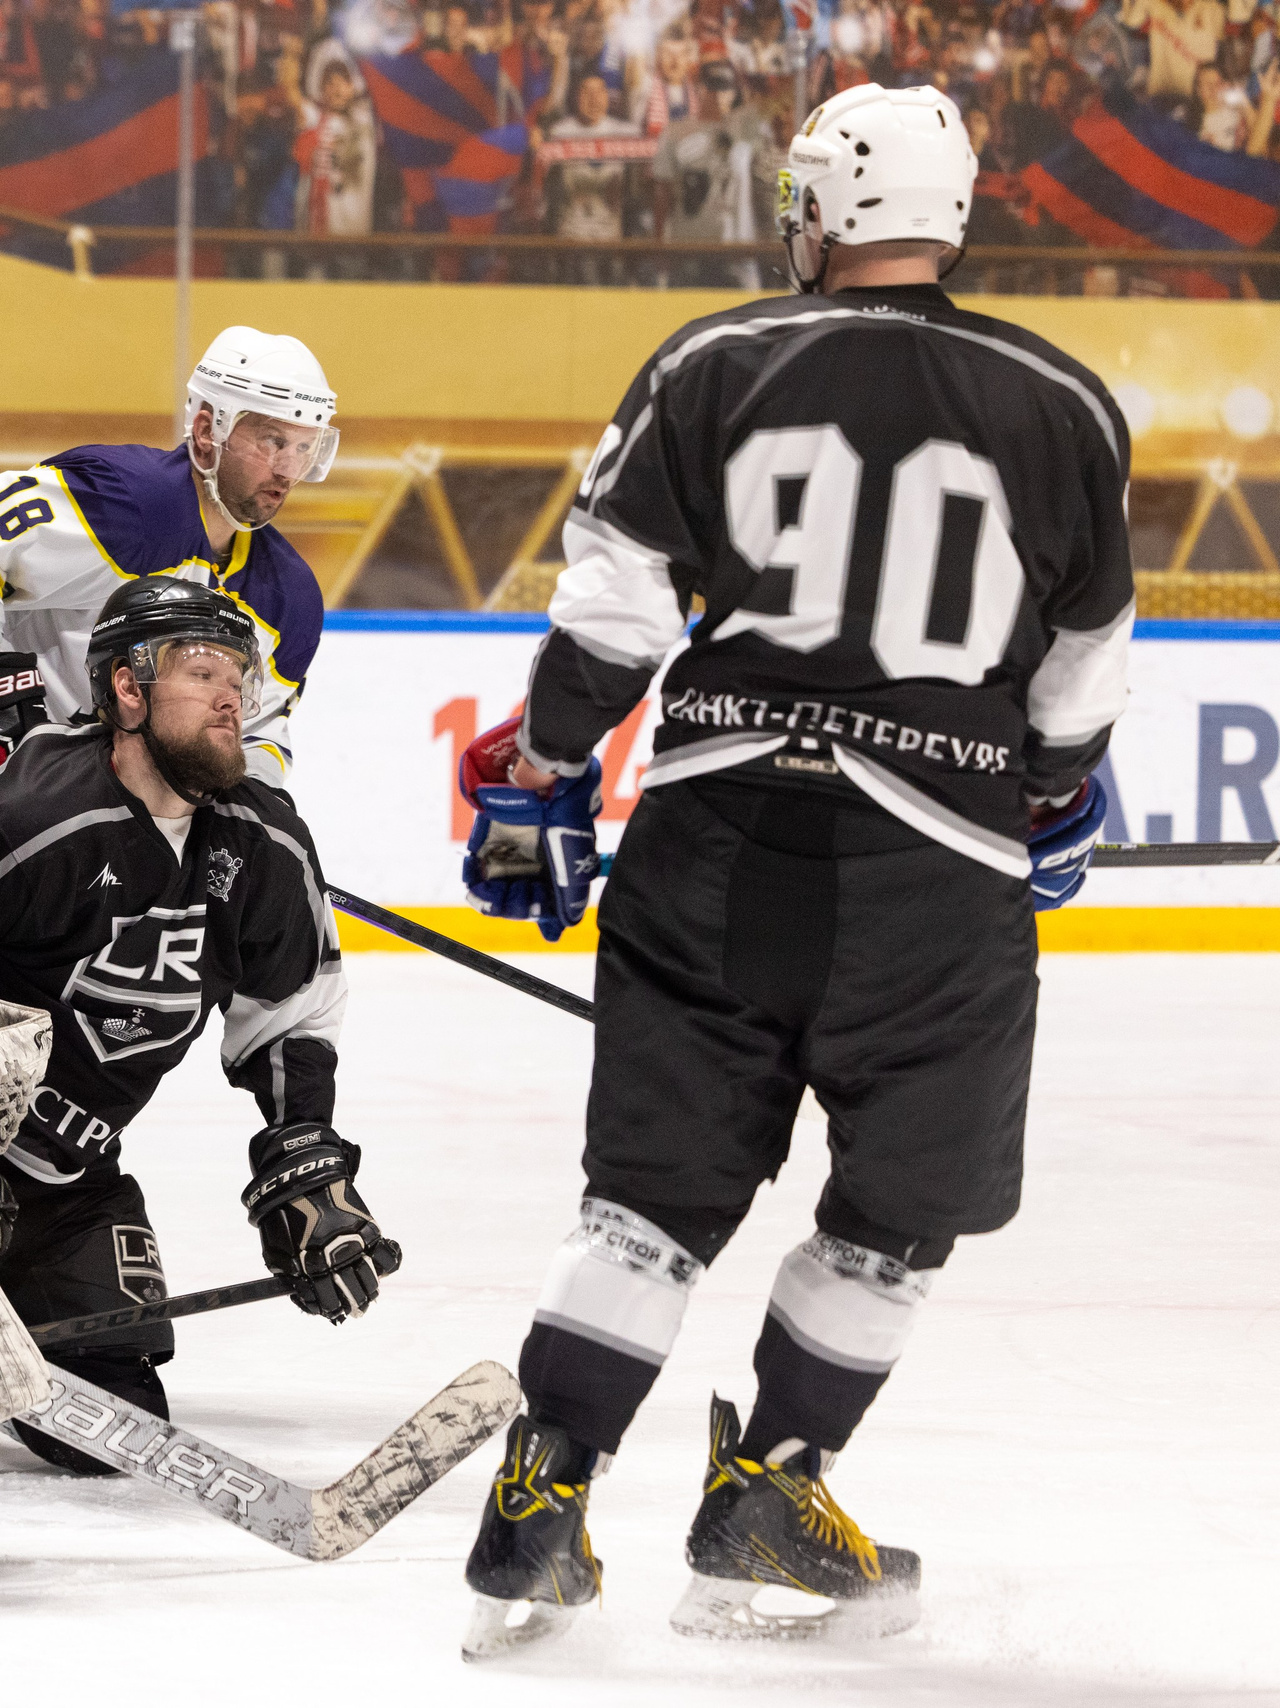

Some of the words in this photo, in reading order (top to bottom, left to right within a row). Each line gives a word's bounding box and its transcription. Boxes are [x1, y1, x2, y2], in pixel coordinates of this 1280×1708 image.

[196, 364, 223, 380] BAUER
[294, 391, 328, 405] BAUER
[712, 422, 1025, 687] 90
[93, 614, 127, 634] BAUER
[218, 609, 251, 628] BAUER
[283, 1131, 321, 1151] CCM
[119, 1234, 161, 1268] LR
